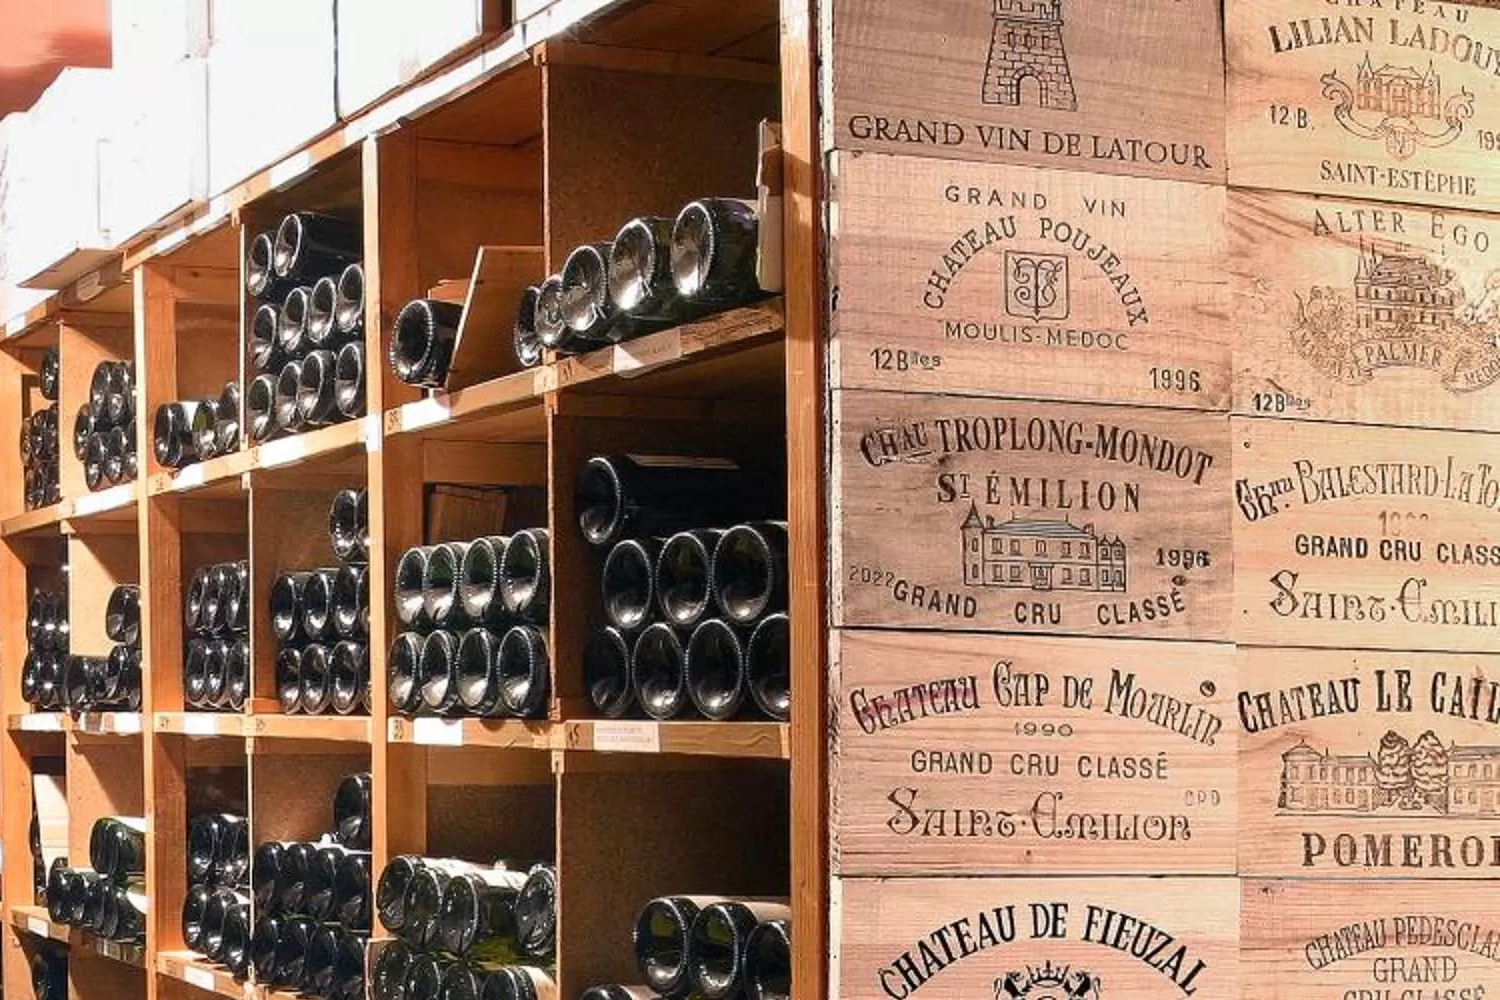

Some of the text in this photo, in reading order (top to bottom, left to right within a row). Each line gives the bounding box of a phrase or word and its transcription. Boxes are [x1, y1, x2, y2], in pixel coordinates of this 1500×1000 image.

[1268, 16, 1373, 53] LILIAN
[848, 115, 1212, 168] GRAND VIN DE LATOUR
[945, 186, 1126, 218] GRAND VIN
[1313, 209, 1490, 253] ALTER EGO
[923, 215, 1149, 327] CHATEAU POUJEAUX
[945, 320, 1129, 351] MOULIS-MEDOC
[1365, 342, 1442, 368] PALMER
[1150, 367, 1201, 392] 1996
[935, 416, 1213, 486] TROPLONG-MONDOT
[986, 471, 1141, 513] ÉMILION
[1295, 534, 1369, 559] GRAND
[1380, 538, 1422, 562] CRU
[894, 580, 1186, 626] GRAND CRU CLASSÉ
[993, 660, 1049, 708] CAP
[1063, 675, 1094, 710] DE
[1237, 678, 1361, 734] CHATEAU
[1375, 669, 1412, 713] LE
[1013, 722, 1074, 738] 1990
[911, 749, 1169, 780] GRAND CRU CLASSÉ
[878, 902, 1209, 1000] CHATEAU DE FIEUZAL
[1305, 918, 1386, 971] CHATEAU
[1373, 956, 1458, 983] GRAND
